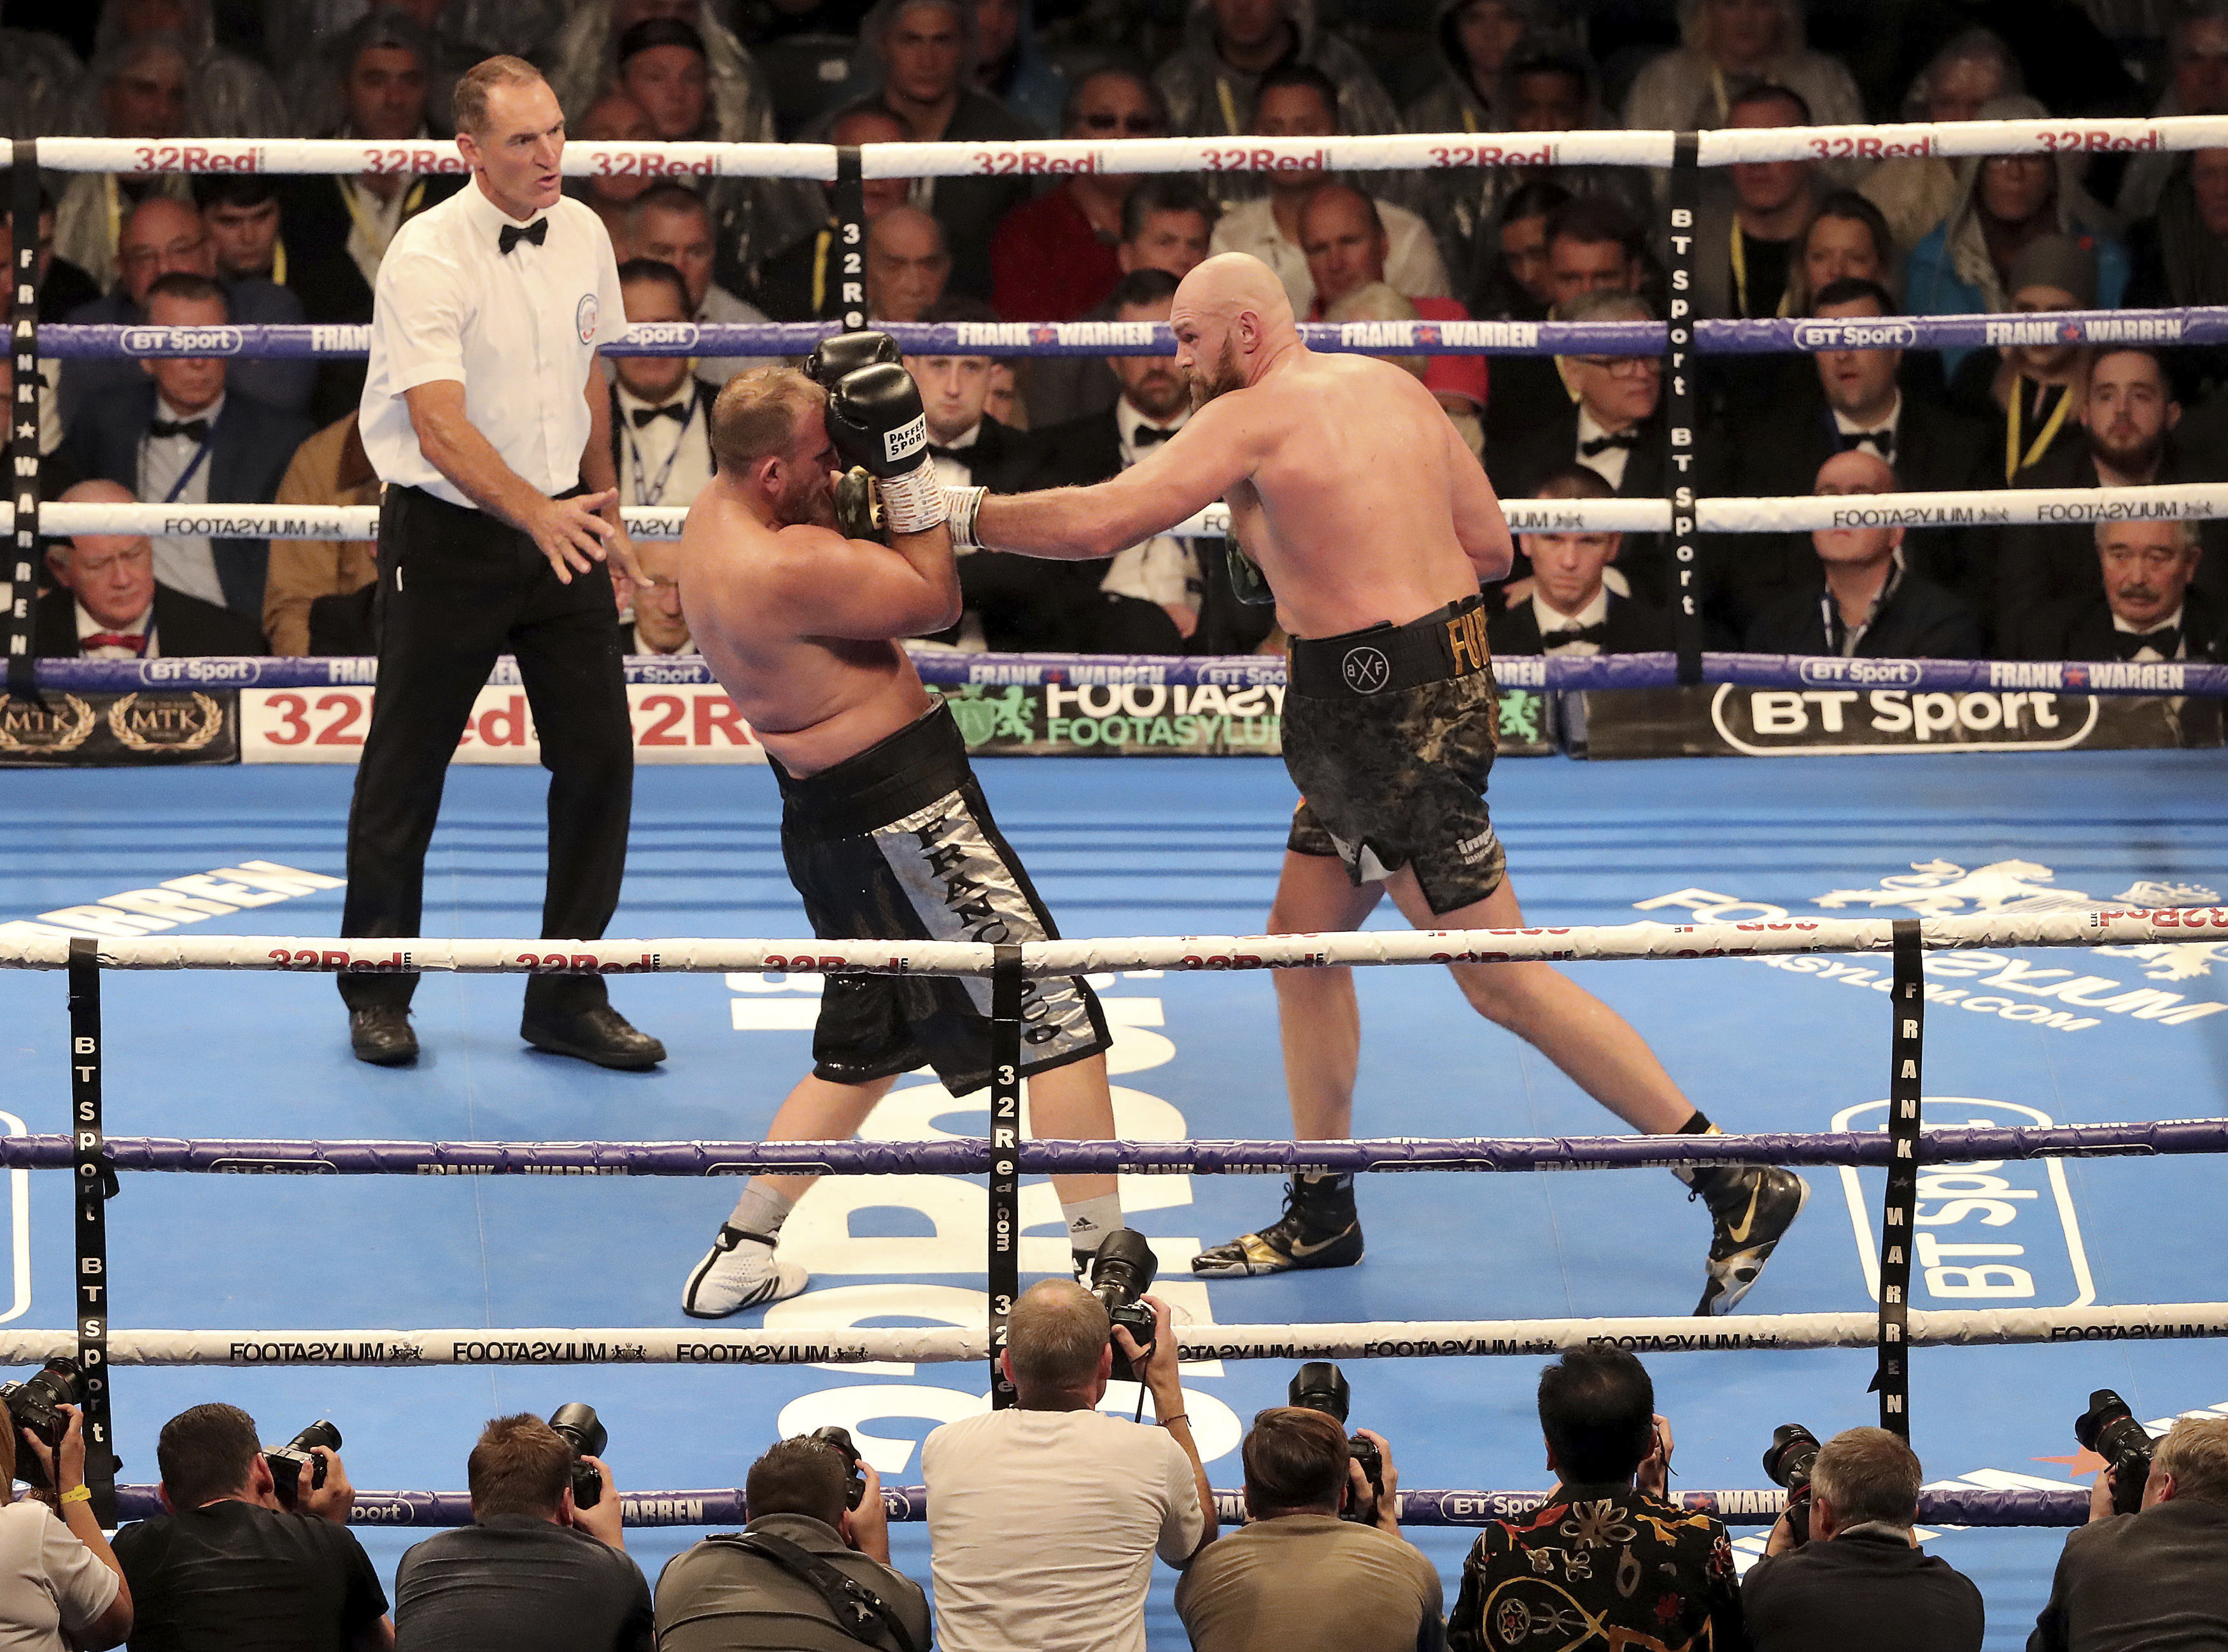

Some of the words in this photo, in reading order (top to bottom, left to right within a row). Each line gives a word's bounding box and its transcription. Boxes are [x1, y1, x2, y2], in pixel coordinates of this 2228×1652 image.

[1809, 137, 1929, 159] 32Red
[2035, 130, 2157, 152] 32Red
[134, 148, 255, 173] 32Red
[364, 150, 471, 173] 32Re
[590, 153, 712, 177] 32Red
[973, 152, 1095, 175] 32Red
[1201, 148, 1323, 171] 32Red
[1429, 145, 1551, 167] 32Red
[132, 331, 167, 349] BT
[171, 330, 230, 353] Sport
[312, 326, 370, 351] FRAN
[957, 323, 1030, 346] FRANK
[1057, 322, 1153, 346] WARREN
[1341, 323, 1414, 348] FRANK
[1441, 323, 1538, 348] WARREN
[1806, 327, 1840, 345] BT
[1843, 327, 1903, 348] Sport
[1986, 321, 2059, 345] FRANK
[2085, 319, 2182, 342] WARREN
[889, 418, 924, 444] PAFFEN
[891, 430, 925, 456] SPORT
[151, 663, 183, 679] BT
[190, 661, 248, 682] Sport
[969, 665, 1042, 685] FRANK
[1069, 666, 1166, 685] WARREN
[1246, 667, 1287, 686] Spo
[1812, 663, 1848, 680] BT
[1849, 664, 1908, 683] Sport
[1990, 663, 2063, 688] FRANK
[2088, 665, 2185, 689] WARREN
[132, 709, 199, 730] MTK
[1752, 691, 1859, 734] BT
[1870, 689, 2059, 740] Sport
[1051, 716, 1281, 745] FOOTASYLU
[1915, 1232, 2034, 1298] BT
[230, 1343, 383, 1361] FOOTASYLUM
[452, 1342, 606, 1361] FOOTASYLUM
[676, 1344, 829, 1362] FOOTASYLUM
[1178, 1345, 1294, 1360] OTASYLUM
[1364, 1339, 1516, 1358] FOOTASYLUM
[351, 1504, 400, 1522] port
[1454, 1498, 1488, 1514] BT
[1717, 1491, 1788, 1514] WARR
